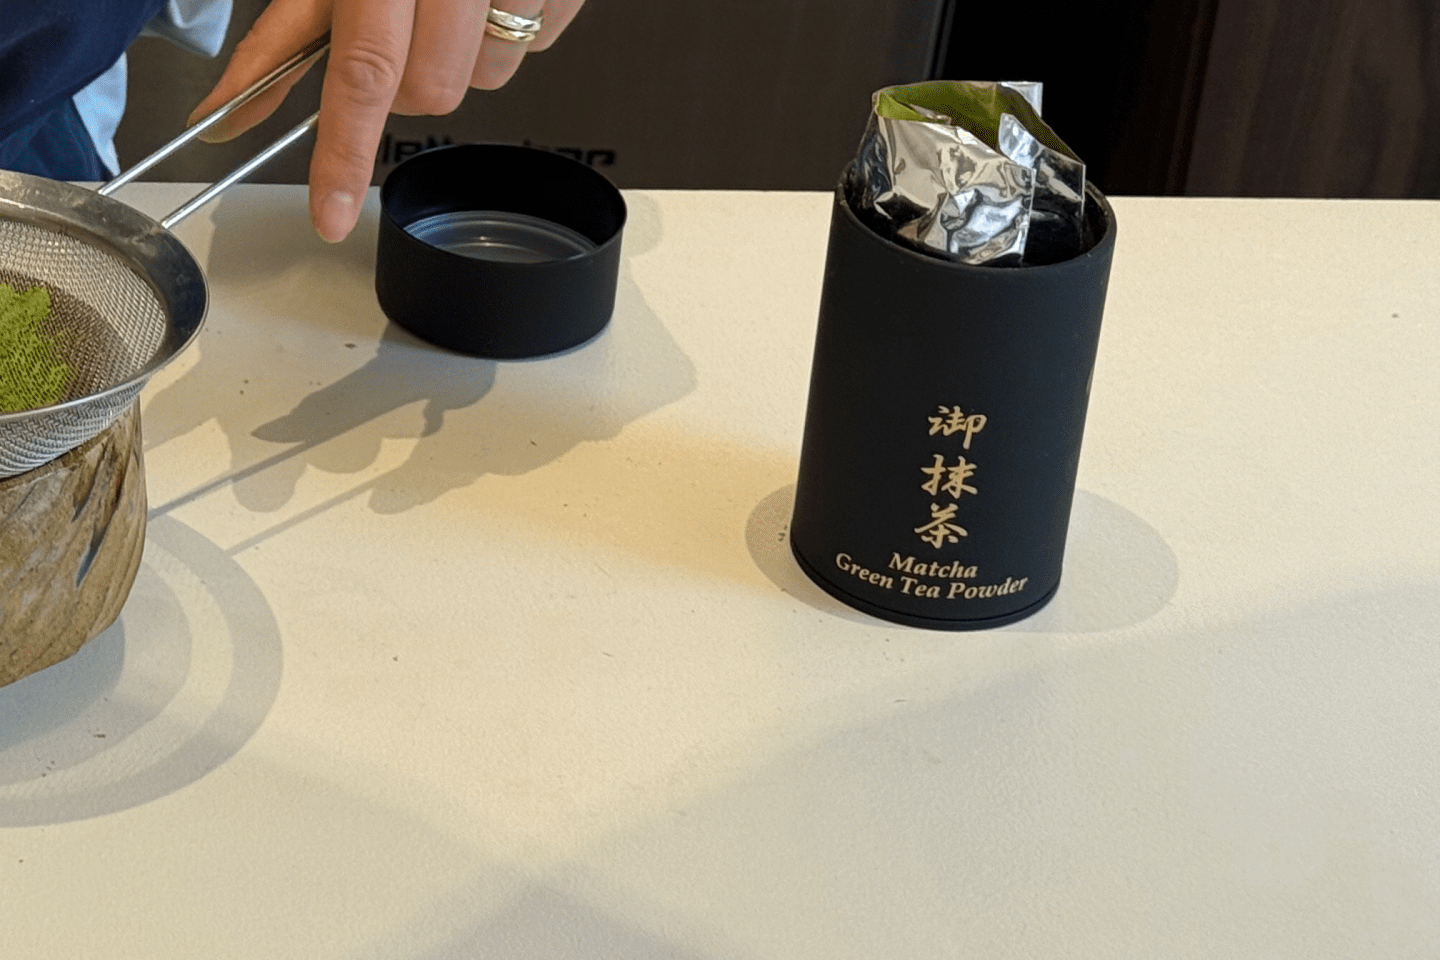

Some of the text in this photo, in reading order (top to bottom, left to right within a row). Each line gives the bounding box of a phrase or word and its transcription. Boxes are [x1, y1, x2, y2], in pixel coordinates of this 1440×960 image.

[913, 405, 988, 549] 御抹茶
[834, 552, 1028, 601] Green Tea Powder
[887, 551, 978, 579] Matcha
